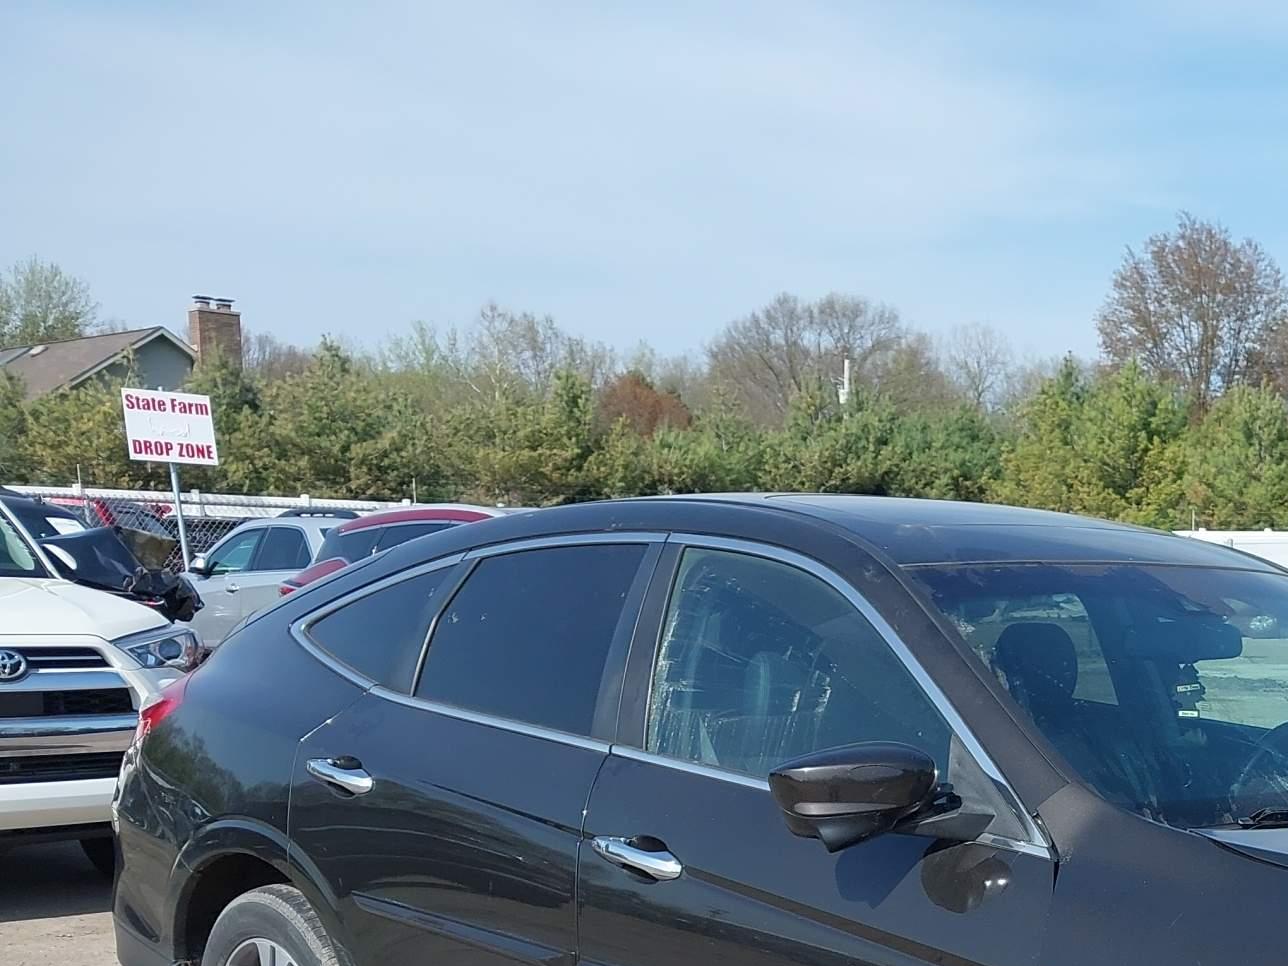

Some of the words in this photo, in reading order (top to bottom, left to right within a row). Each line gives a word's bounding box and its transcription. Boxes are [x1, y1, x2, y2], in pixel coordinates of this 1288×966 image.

[125, 394, 167, 412] State
[171, 399, 209, 416] Farm
[132, 440, 173, 456] DROP
[178, 443, 214, 459] ZONE
